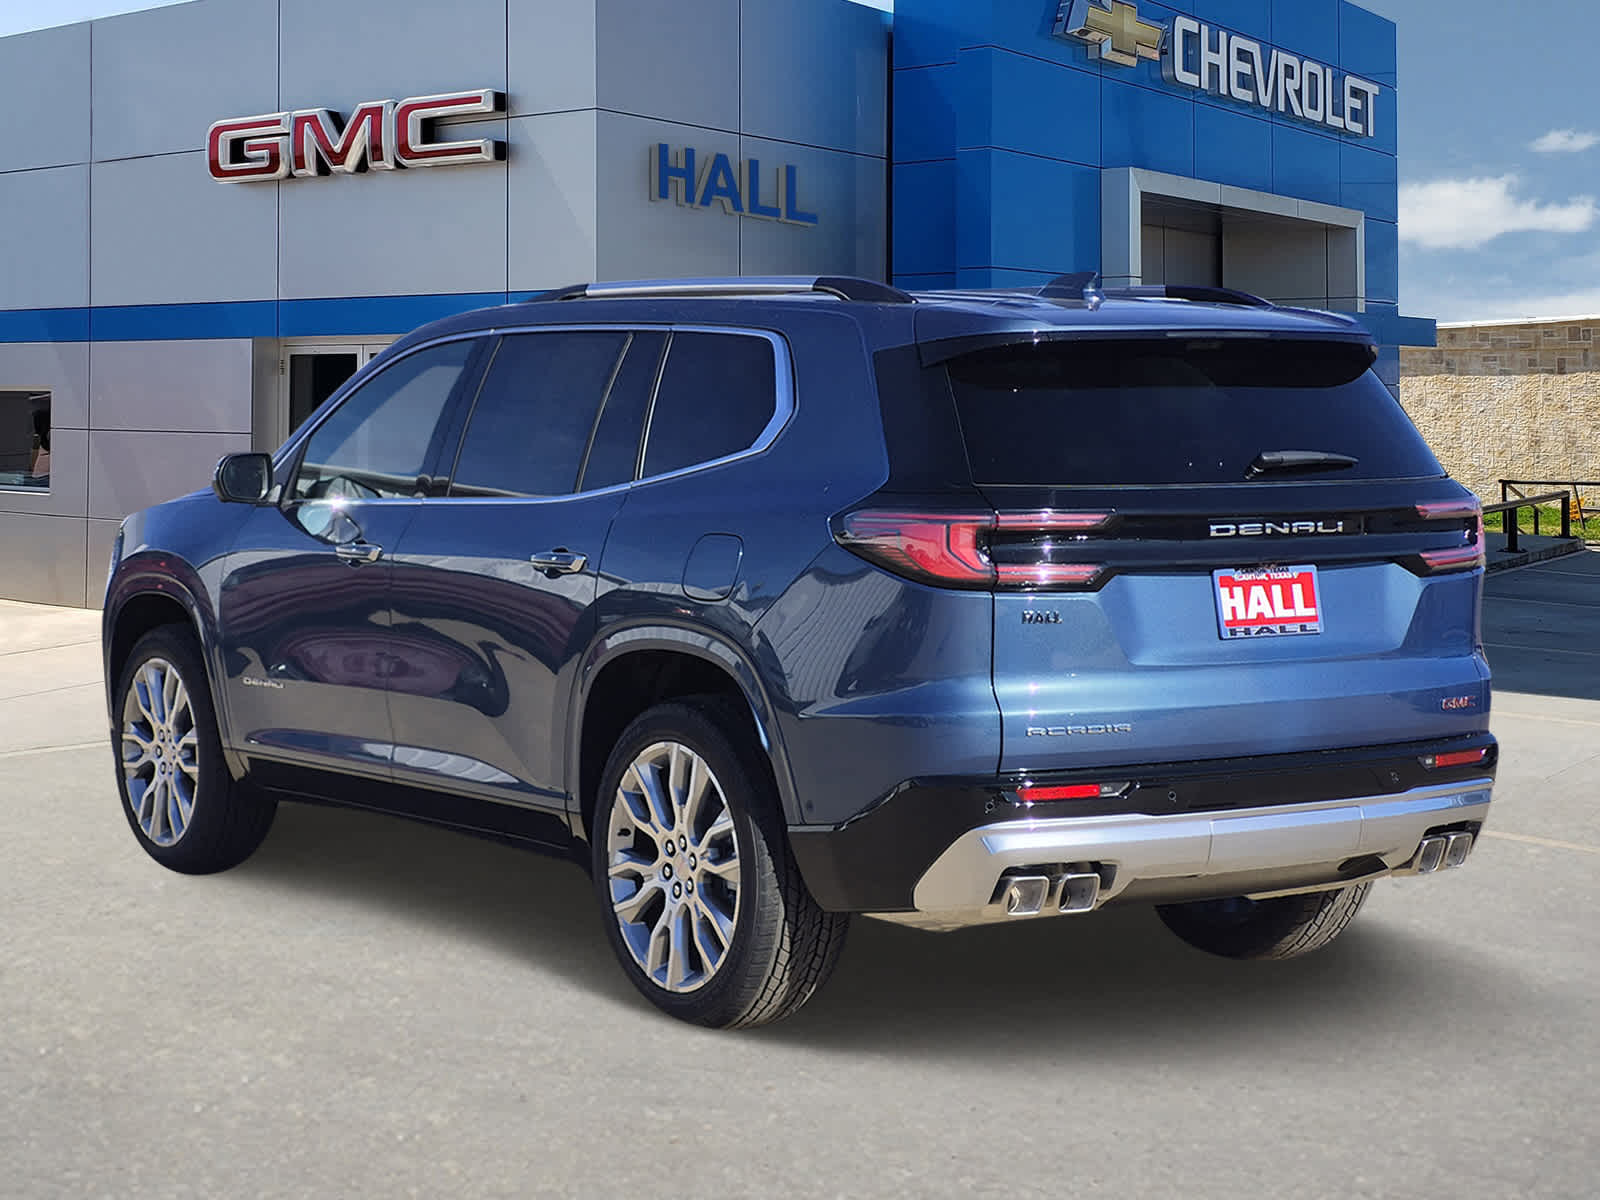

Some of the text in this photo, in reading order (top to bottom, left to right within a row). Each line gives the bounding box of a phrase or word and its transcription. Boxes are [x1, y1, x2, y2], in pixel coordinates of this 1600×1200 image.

[1174, 15, 1379, 137] CHEVROLET
[206, 88, 508, 184] GMC
[651, 142, 818, 226] HALL
[1209, 521, 1343, 537] DENALI
[1220, 584, 1316, 620] HALL
[1230, 624, 1318, 637] HALL
[1026, 724, 1132, 737] ACADIA
